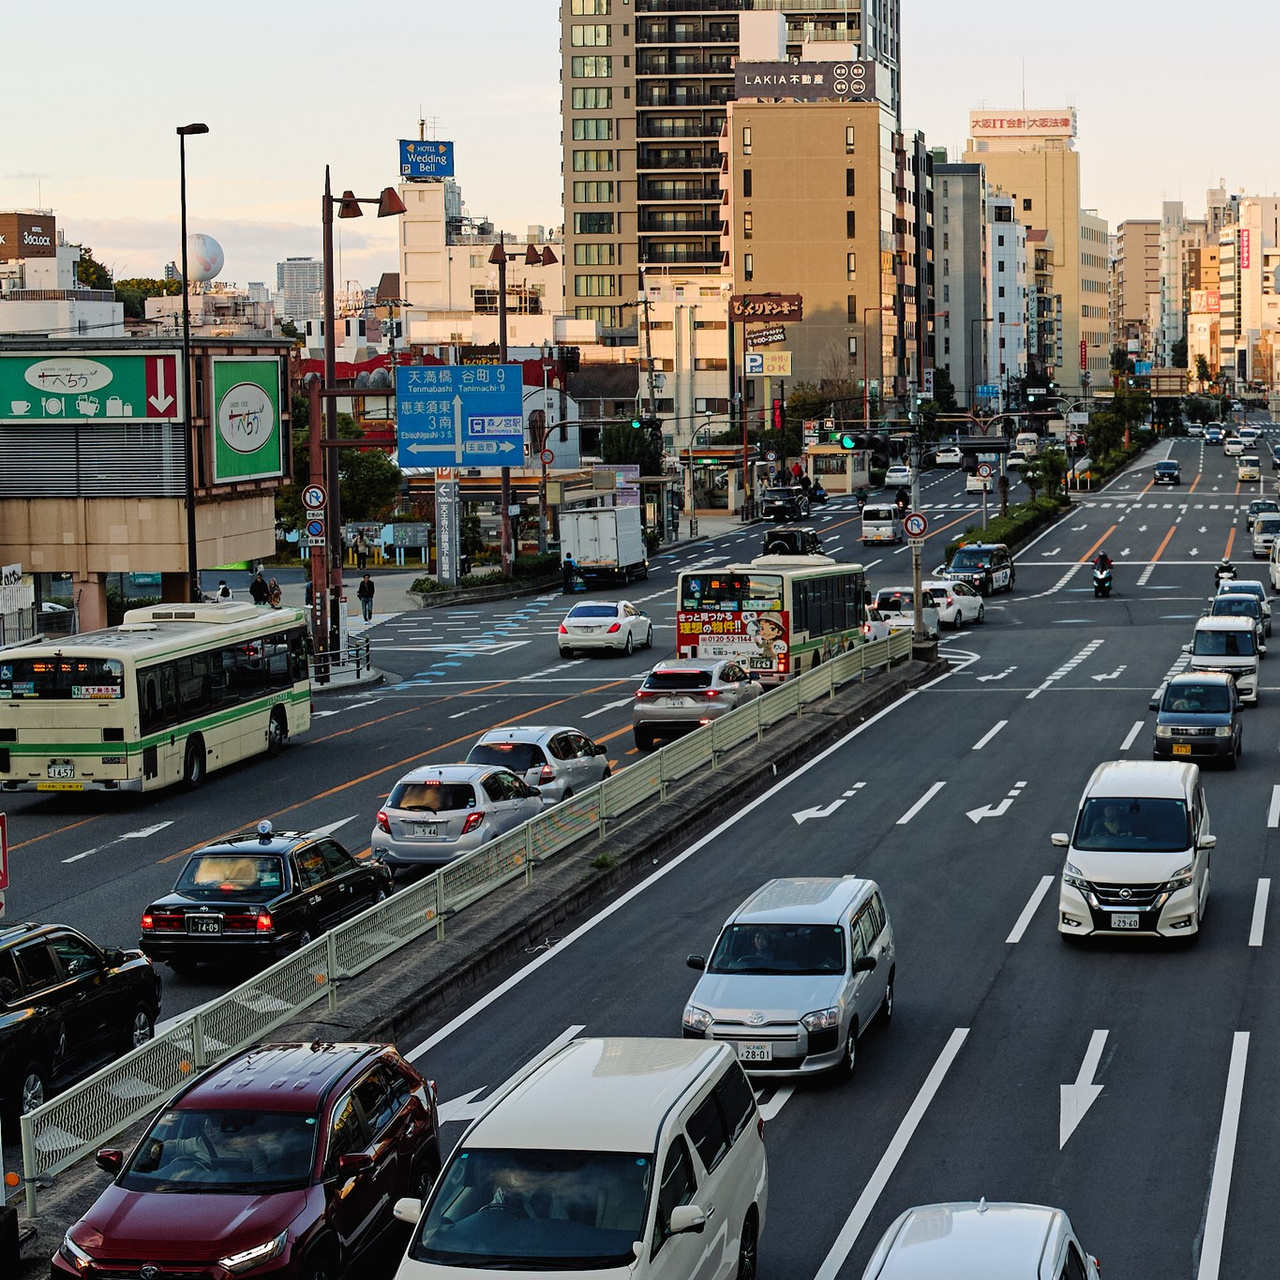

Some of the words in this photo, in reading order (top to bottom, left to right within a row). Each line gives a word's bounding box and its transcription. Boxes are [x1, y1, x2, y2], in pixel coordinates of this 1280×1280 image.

[971, 118, 1026, 129] 大阪IT会計
[417, 145, 436, 153] HOTEL
[407, 153, 447, 166] Wedding
[419, 163, 436, 172] Bell
[732, 301, 799, 316] びっくりドンキー
[766, 364, 787, 372] OK
[408, 369, 453, 384] 天満橋
[462, 368, 490, 384] 谷町
[496, 368, 506, 383] 9
[407, 384, 453, 393] Tenmabashi
[401, 400, 451, 415] 恵美須東
[487, 417, 521, 429] 森ノ宮駅
[678, 611, 733, 622] きっと見つかる
